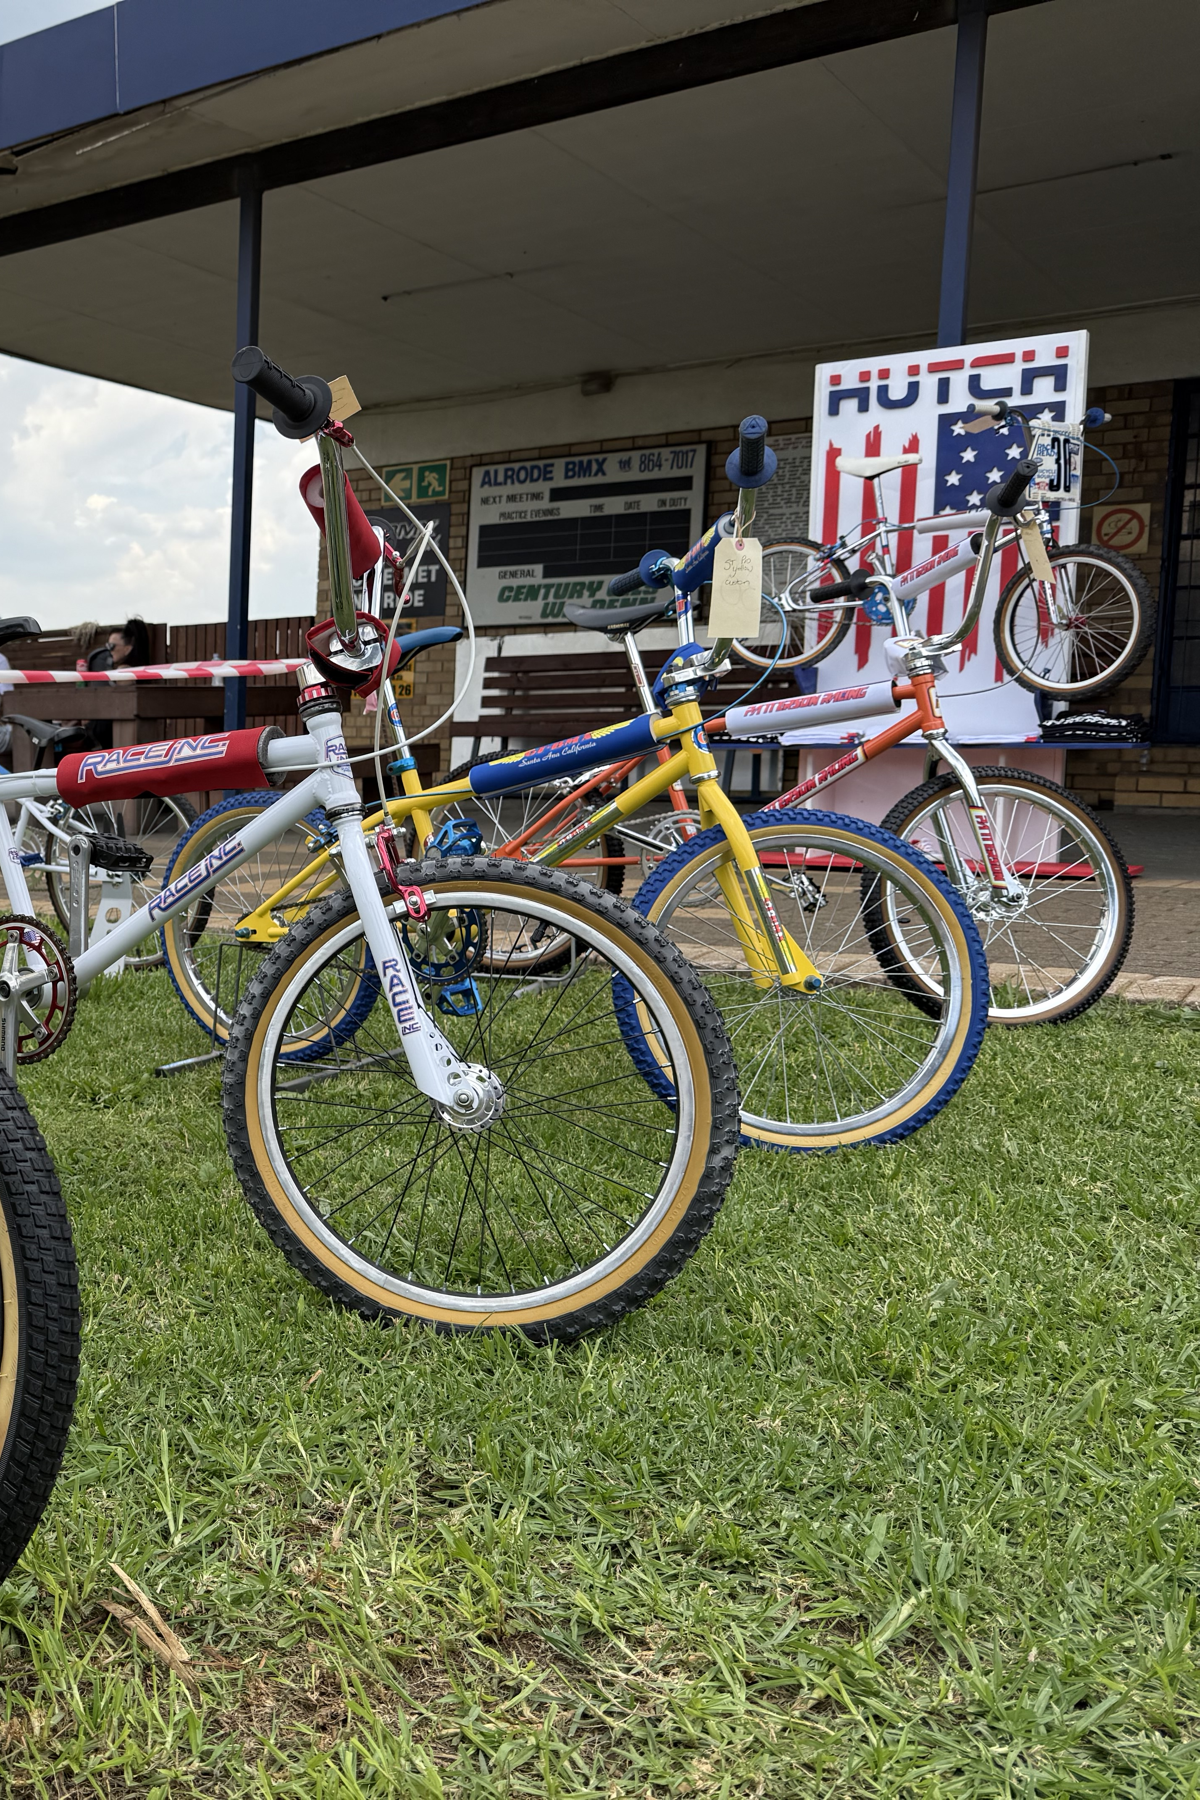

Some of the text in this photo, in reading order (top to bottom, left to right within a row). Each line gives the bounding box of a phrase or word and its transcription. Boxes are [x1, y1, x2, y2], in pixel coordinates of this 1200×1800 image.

[827, 345, 1070, 416] HUTCH
[480, 463, 555, 488] ALRODE
[564, 457, 608, 481] BMX
[639, 449, 698, 474] 864-7017
[480, 492, 544, 506] NEXT MEETING
[589, 496, 688, 514] TIME DATE ON DUTY
[499, 507, 561, 522] PRACTICE EVENINGS
[498, 569, 536, 580] GENERAL
[497, 580, 604, 603] CENTURY
[743, 686, 870, 717] PATTERSON RACING
[518, 742, 597, 768] Santa Ana California
[381, 957, 417, 1026] RACE
